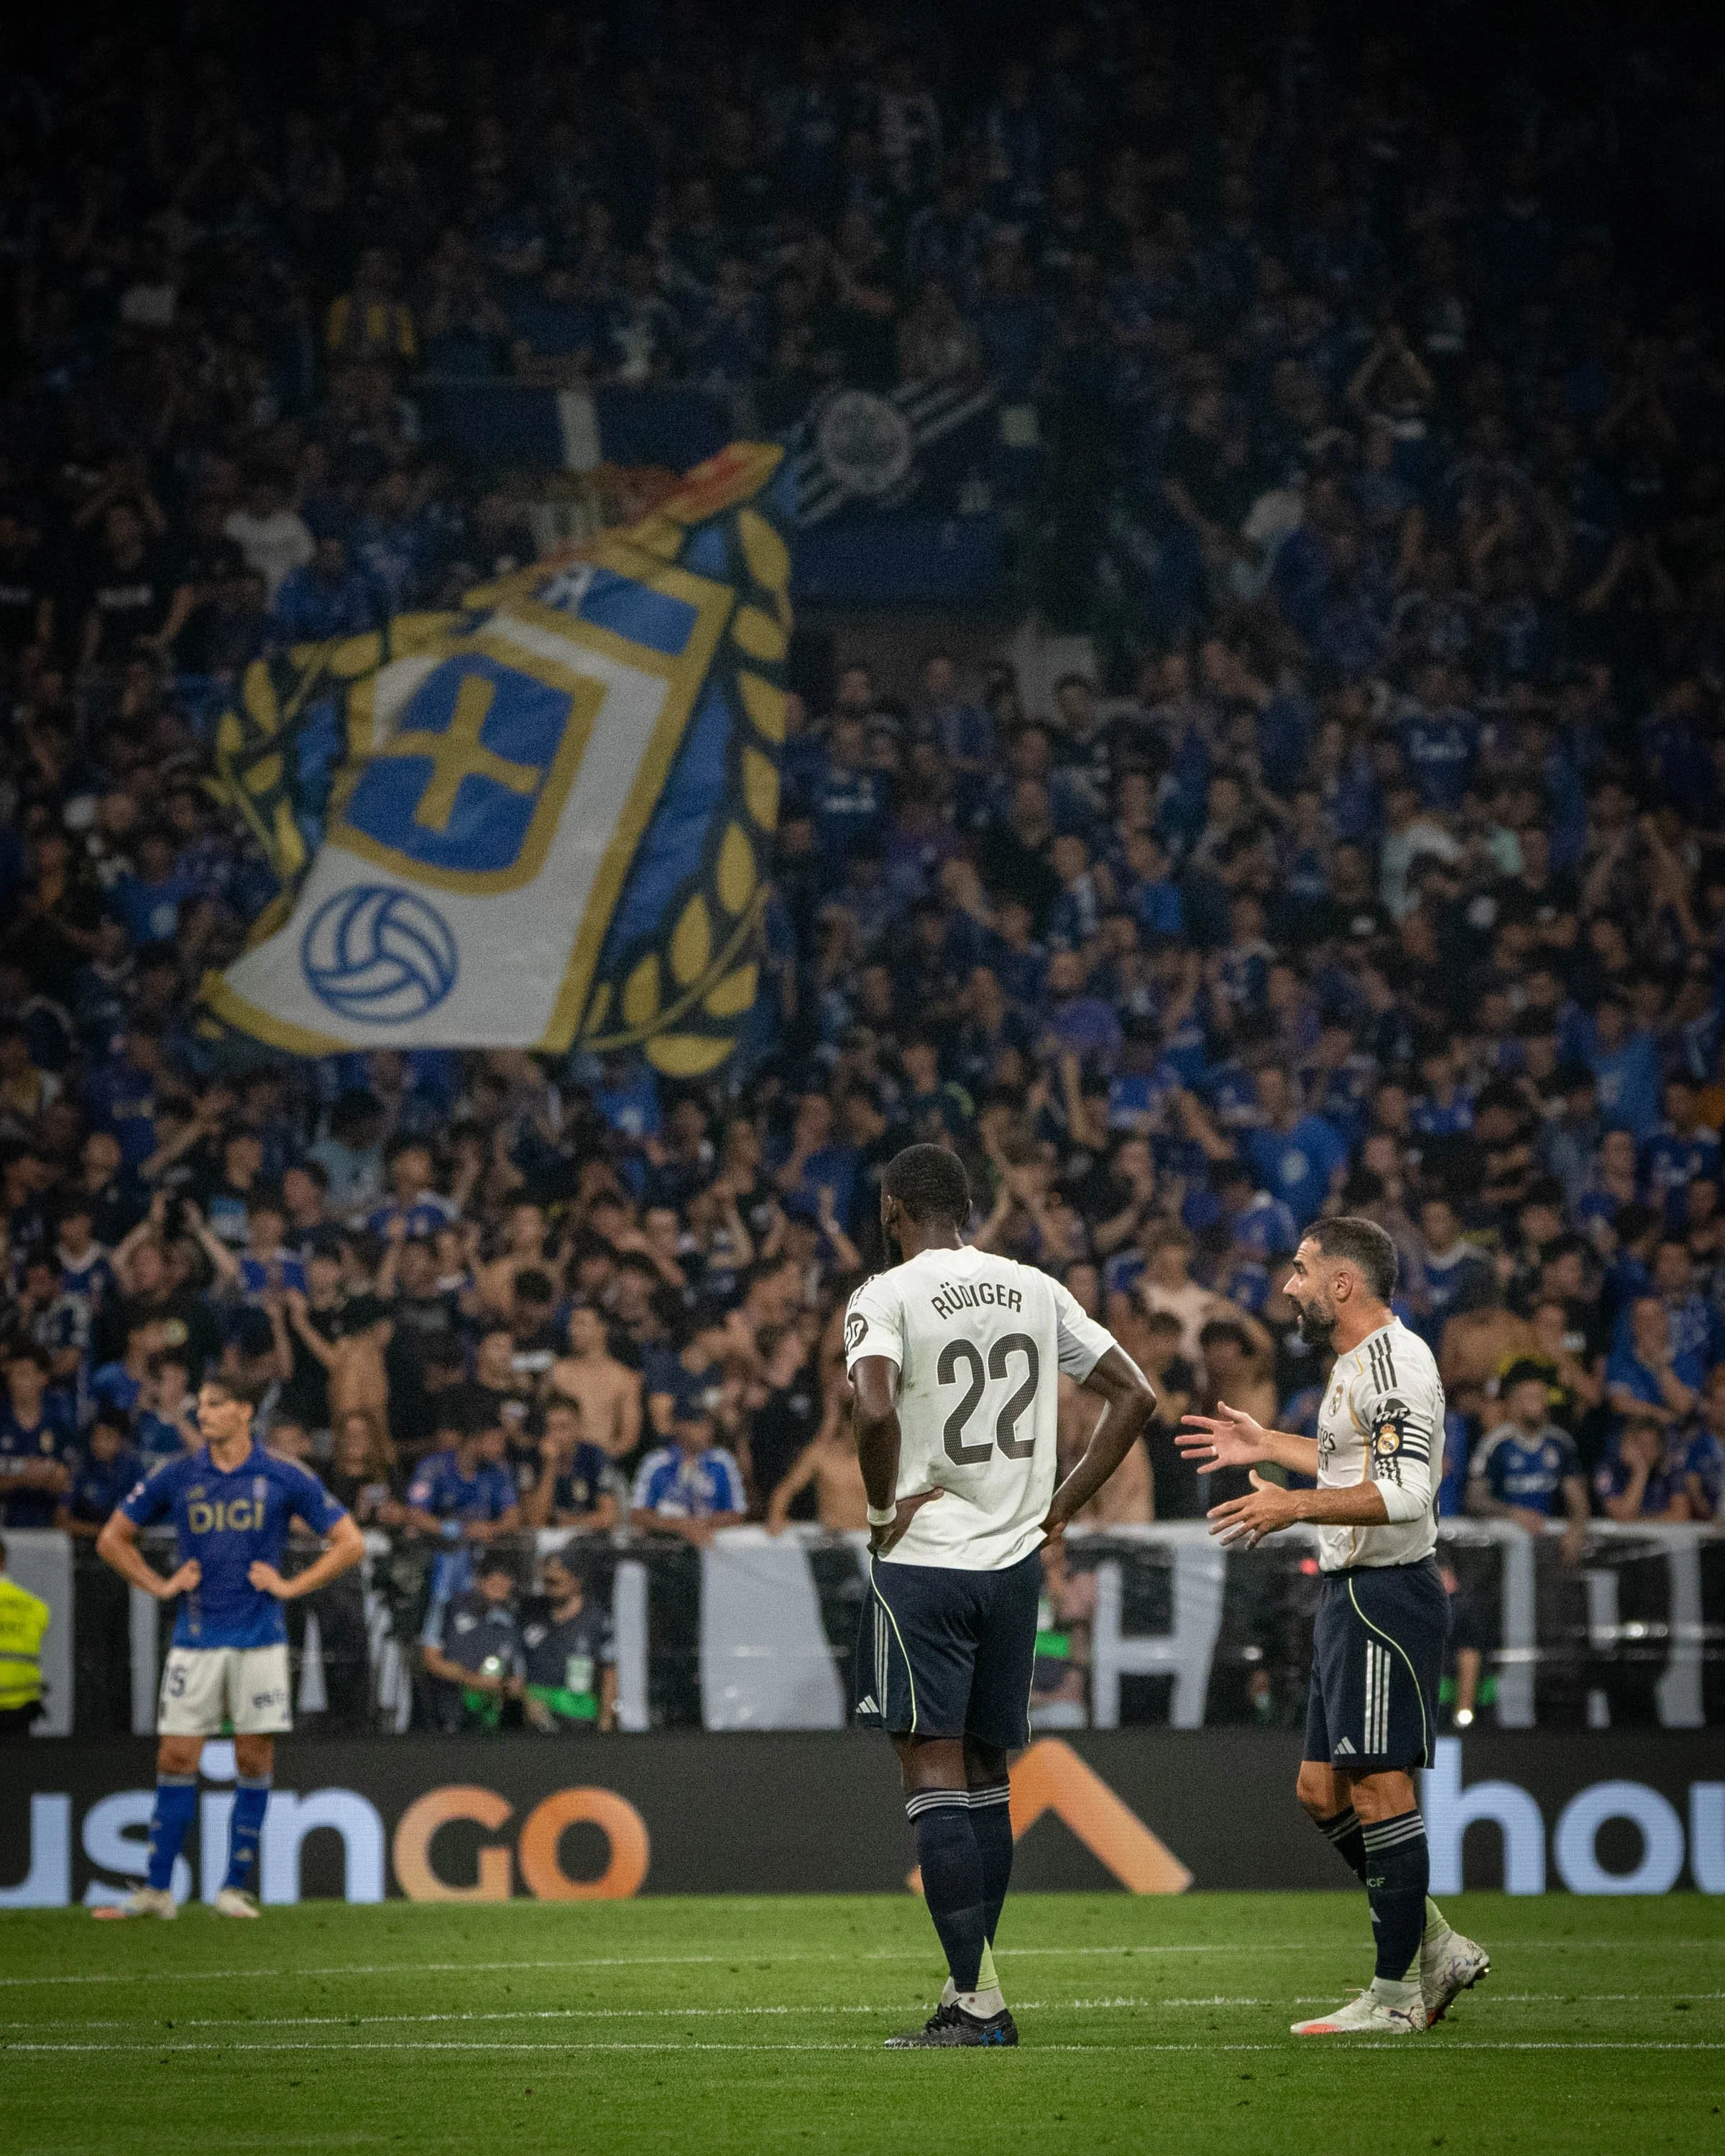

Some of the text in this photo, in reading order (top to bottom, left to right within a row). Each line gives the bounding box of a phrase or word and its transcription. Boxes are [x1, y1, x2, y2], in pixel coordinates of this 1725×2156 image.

[931, 1281, 1022, 1320] RÜDIGER
[937, 1332, 1040, 1467] 22
[188, 1498, 264, 1534] DIGI
[1366, 1876, 1386, 1888] CF
